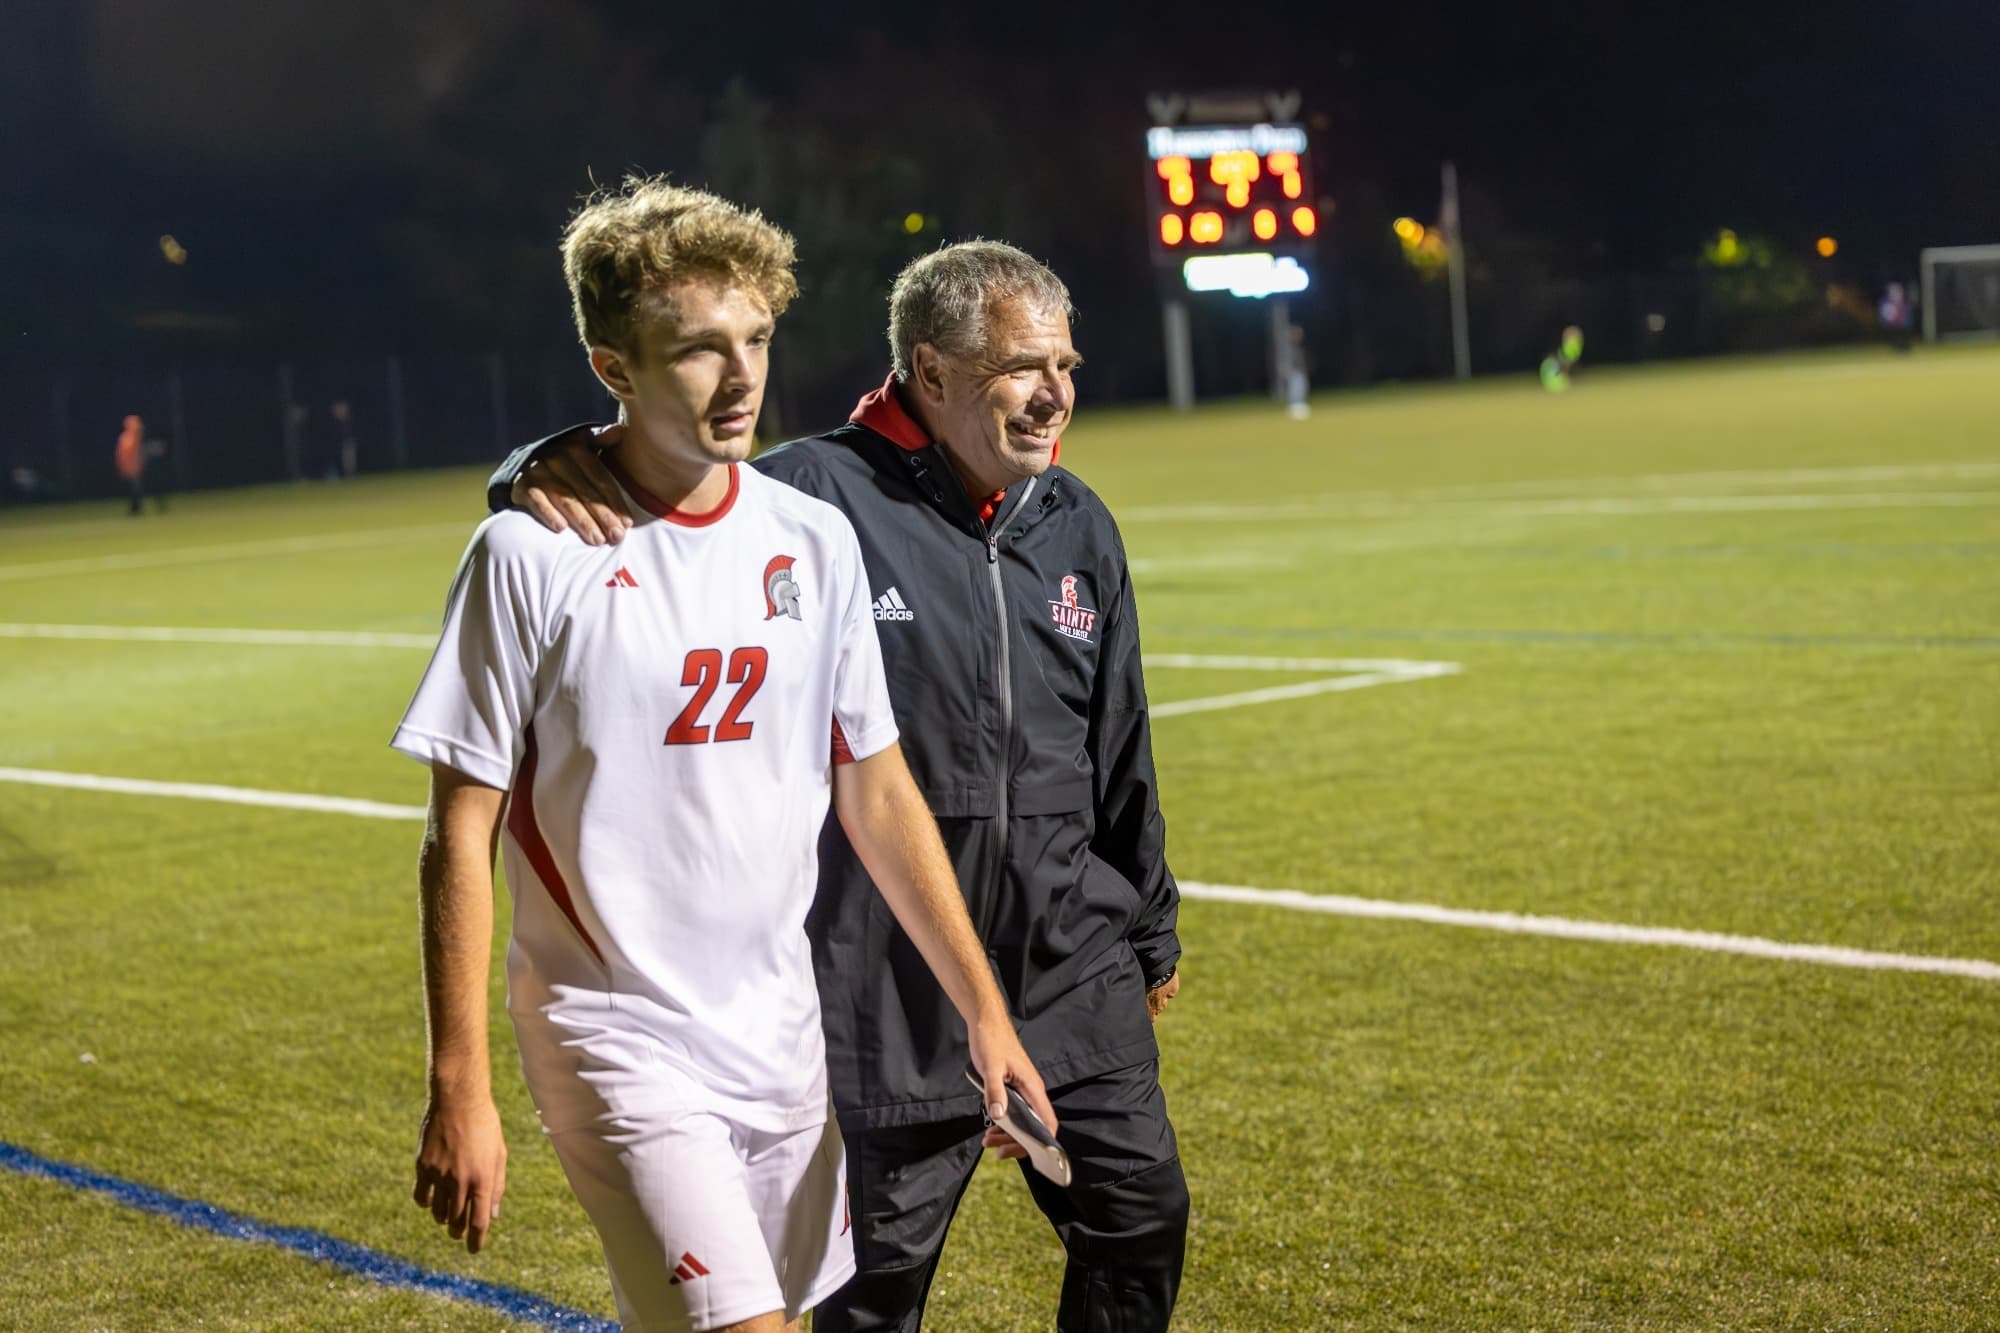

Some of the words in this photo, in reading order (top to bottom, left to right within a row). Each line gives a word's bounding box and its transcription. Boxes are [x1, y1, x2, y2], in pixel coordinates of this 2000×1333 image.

[874, 607, 914, 621] didas
[1052, 604, 1095, 632] SAINTS
[664, 646, 768, 746] 22
